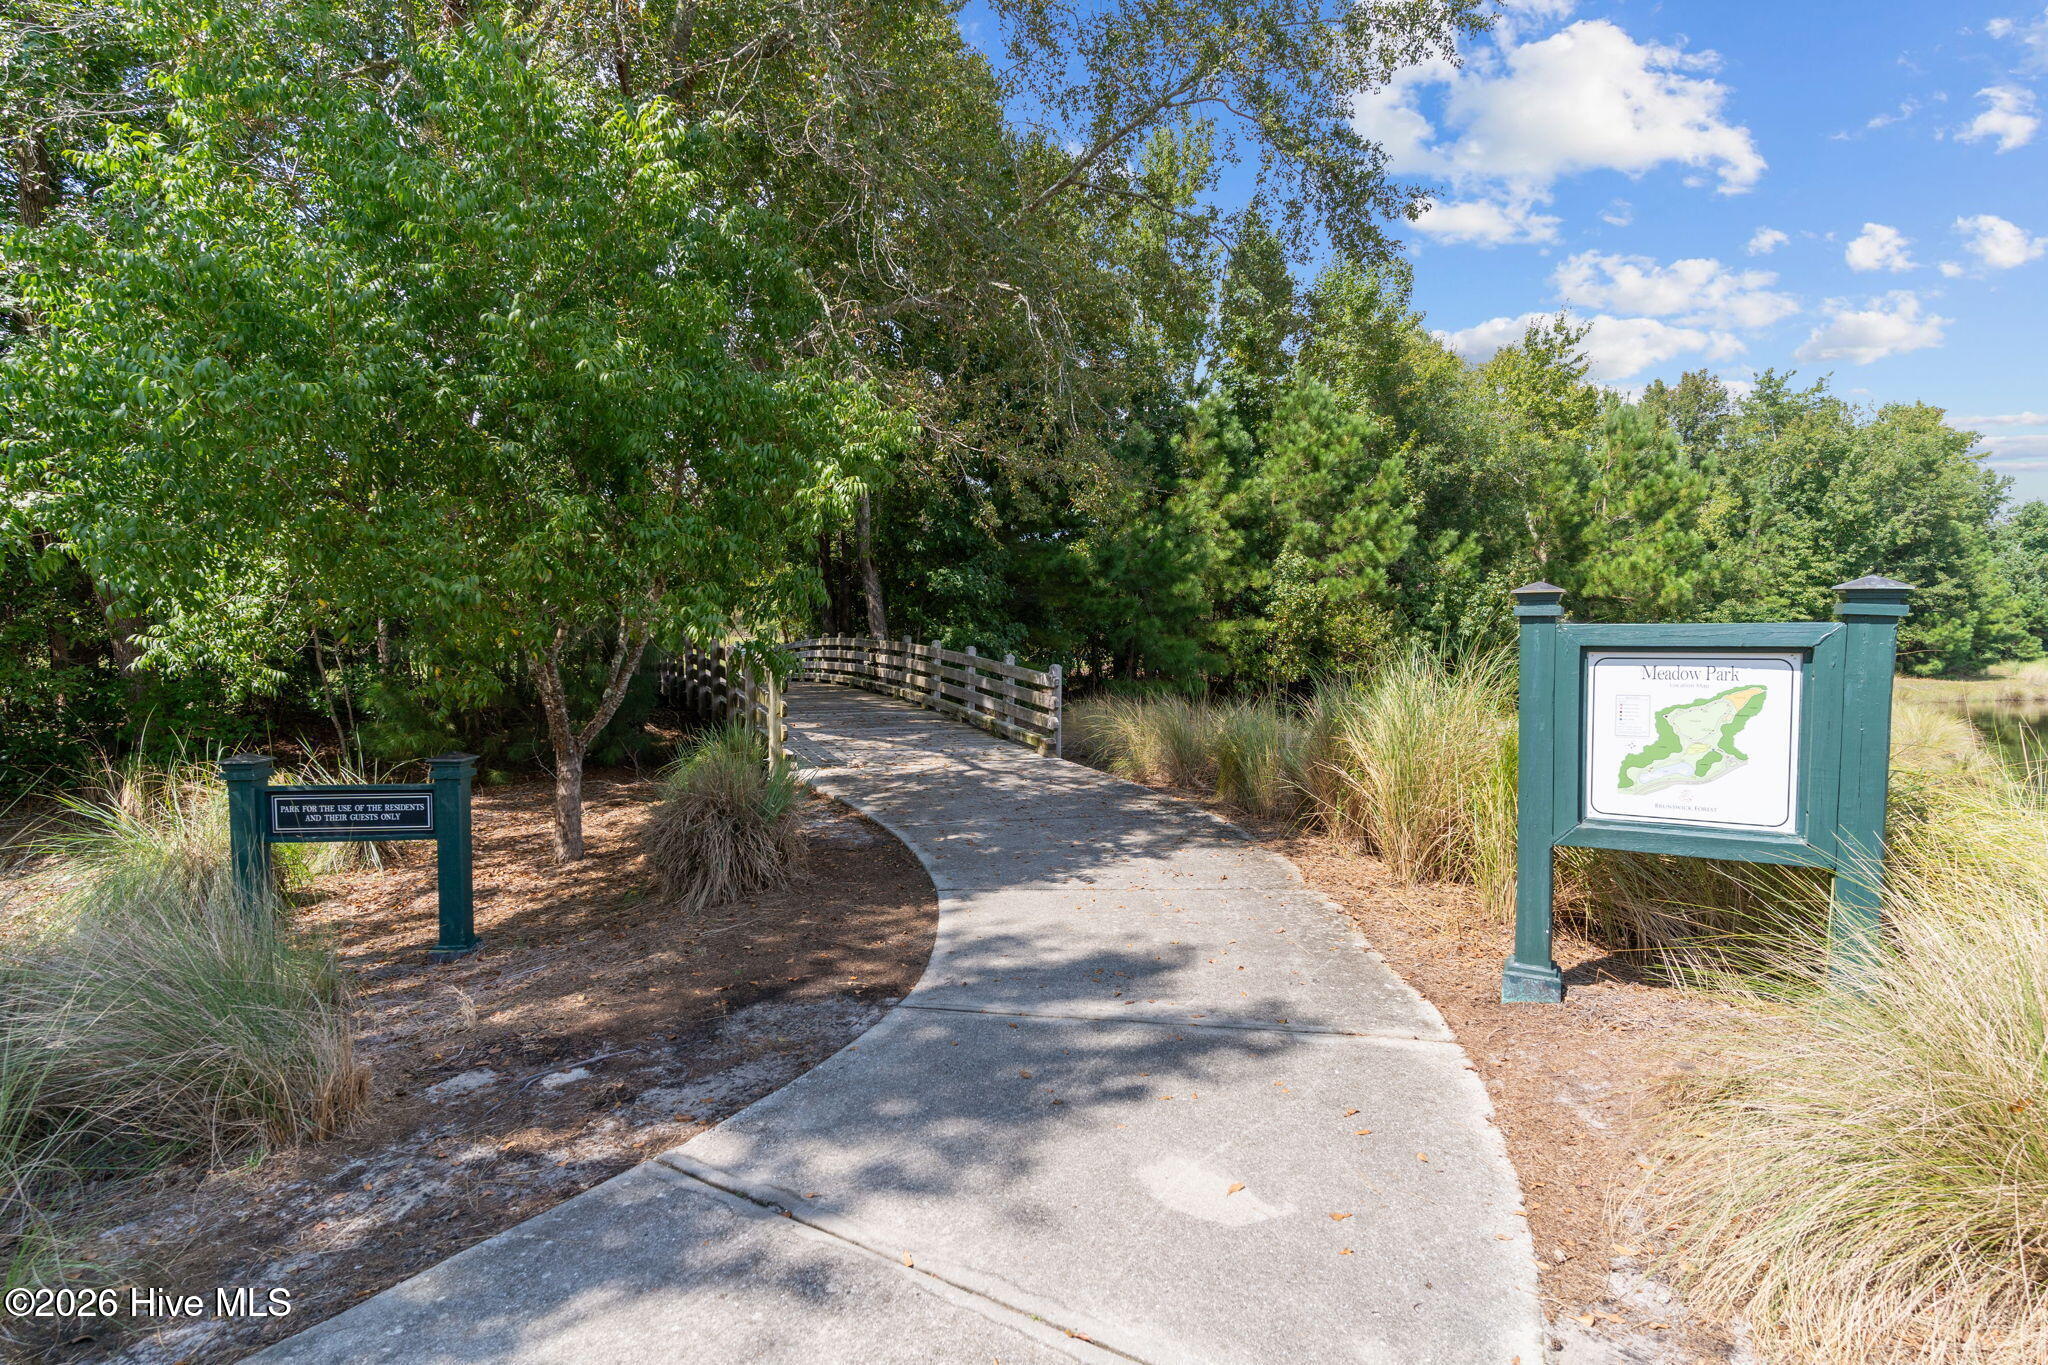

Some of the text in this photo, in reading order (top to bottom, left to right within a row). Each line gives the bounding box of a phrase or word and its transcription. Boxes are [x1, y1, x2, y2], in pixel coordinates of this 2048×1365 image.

[1641, 664, 1740, 681] Meadow Park
[280, 803, 425, 813] PARK FOR THE USE OF THE RESIDENTS
[305, 812, 401, 822] AND THEIR GUESTS ONLY
